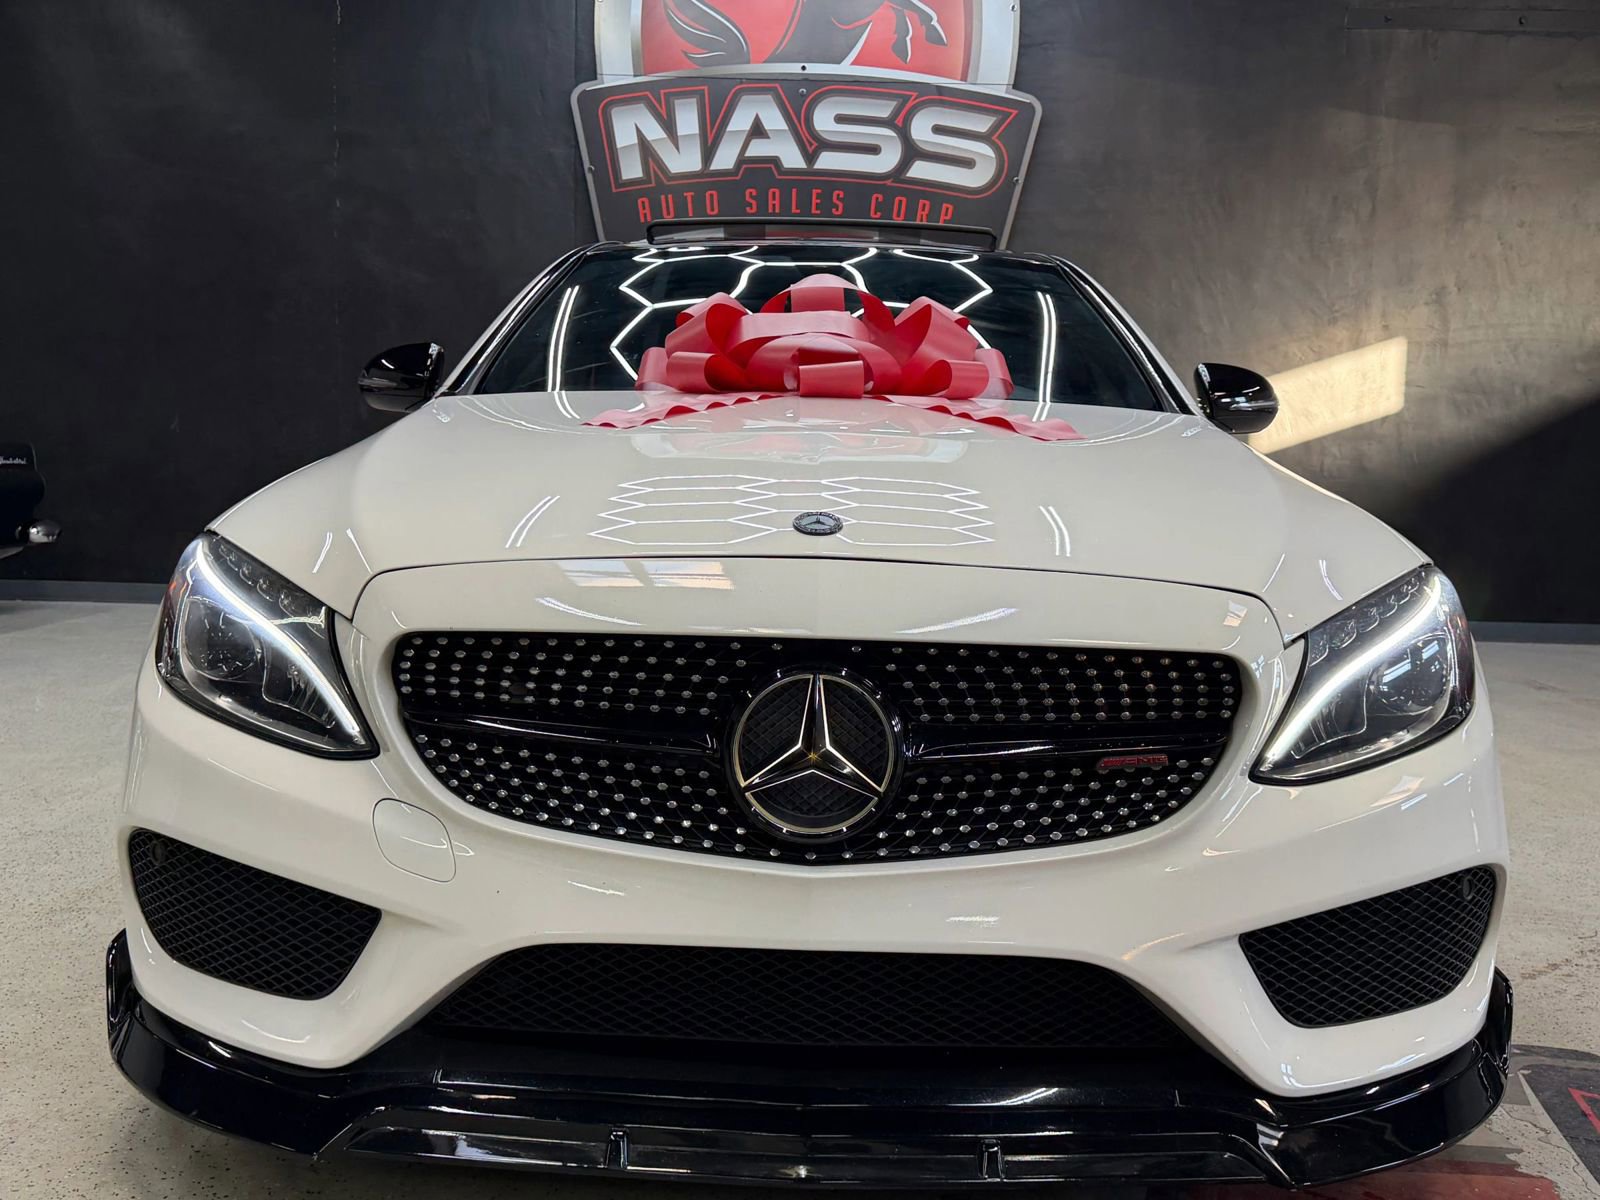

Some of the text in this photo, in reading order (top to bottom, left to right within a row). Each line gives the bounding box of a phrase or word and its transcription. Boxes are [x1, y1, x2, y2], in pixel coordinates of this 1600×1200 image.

[610, 94, 998, 189] NASS
[637, 188, 954, 225] AUTO SALES CORP
